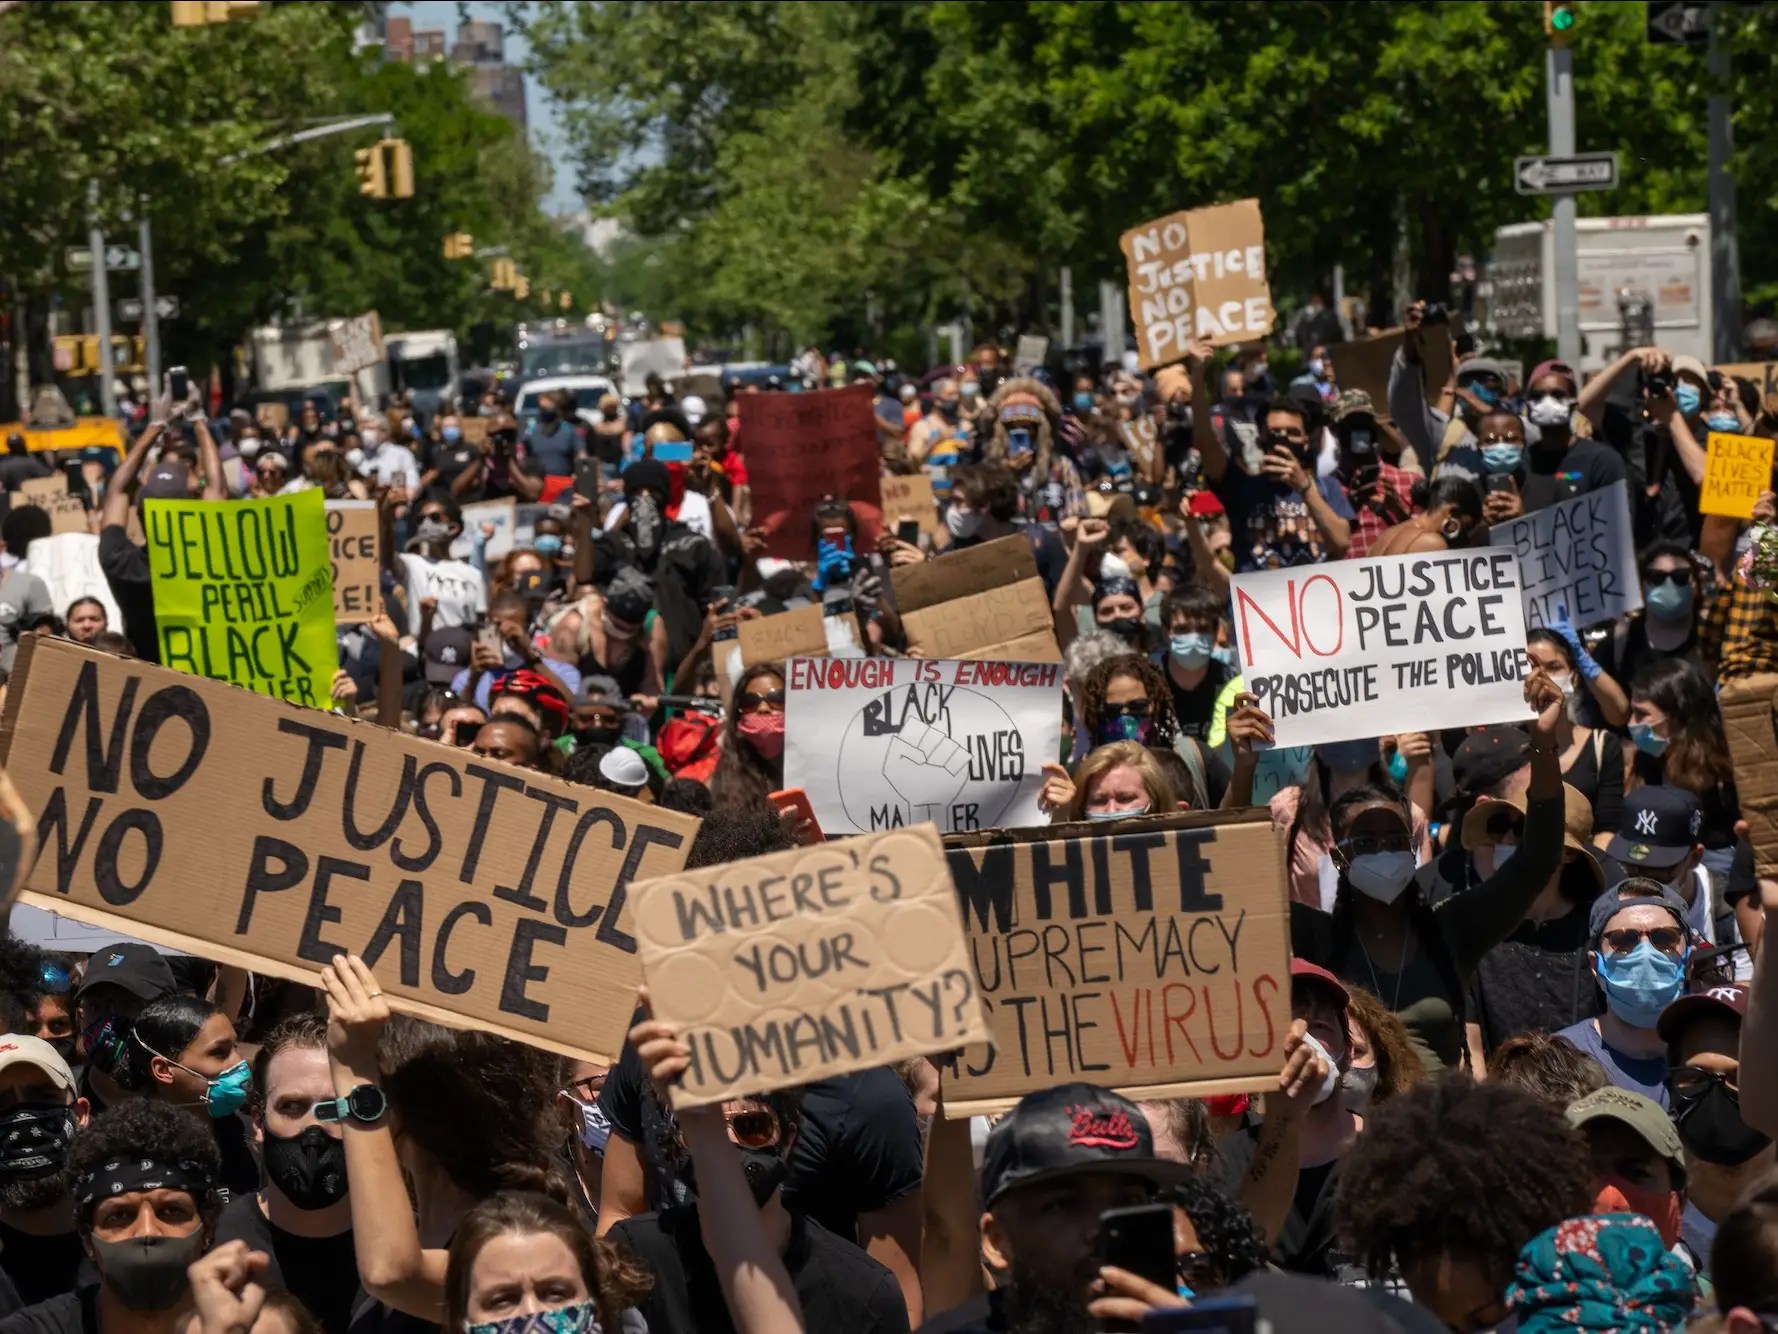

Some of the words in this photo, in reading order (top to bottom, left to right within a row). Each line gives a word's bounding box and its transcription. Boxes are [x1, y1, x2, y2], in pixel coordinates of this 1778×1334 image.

[1132, 222, 1186, 262] NO
[1141, 287, 1190, 326] NO
[1147, 297, 1268, 362] PEACE
[1710, 459, 1764, 480] LIVES
[1714, 439, 1769, 466] BLACK
[152, 504, 299, 581] YELLOW
[1512, 496, 1607, 558] BLACK
[1349, 554, 1516, 602] JUSTICE
[1520, 534, 1607, 591] LIVES
[202, 582, 292, 624] PERIL
[1236, 574, 1344, 667] NO
[1355, 595, 1505, 650] PEACE
[1528, 570, 1626, 628] ATTER
[163, 622, 312, 681] BLACK
[791, 659, 894, 690] ENOUGH
[914, 660, 942, 682] IS
[954, 660, 1055, 688] ENOUGH
[863, 683, 955, 738] BLACK
[1251, 664, 1379, 720] PROSECUTE
[1392, 658, 1438, 690] THE
[1446, 648, 1529, 689] POLICE
[50, 660, 210, 800] NO
[967, 730, 1024, 782] LIVES
[30, 786, 163, 906] NO
[262, 717, 684, 953] JUSTICE
[672, 850, 902, 940] WHERE'S
[945, 825, 1224, 934] WHITE
[235, 835, 567, 1023] PEACE
[973, 908, 1246, 993] UPREMACY
[734, 932, 869, 992] YOUR
[1001, 993, 1111, 1077] THE
[1110, 974, 1279, 1068] VIRUS
[1066, 1109, 1136, 1144] Bulls
